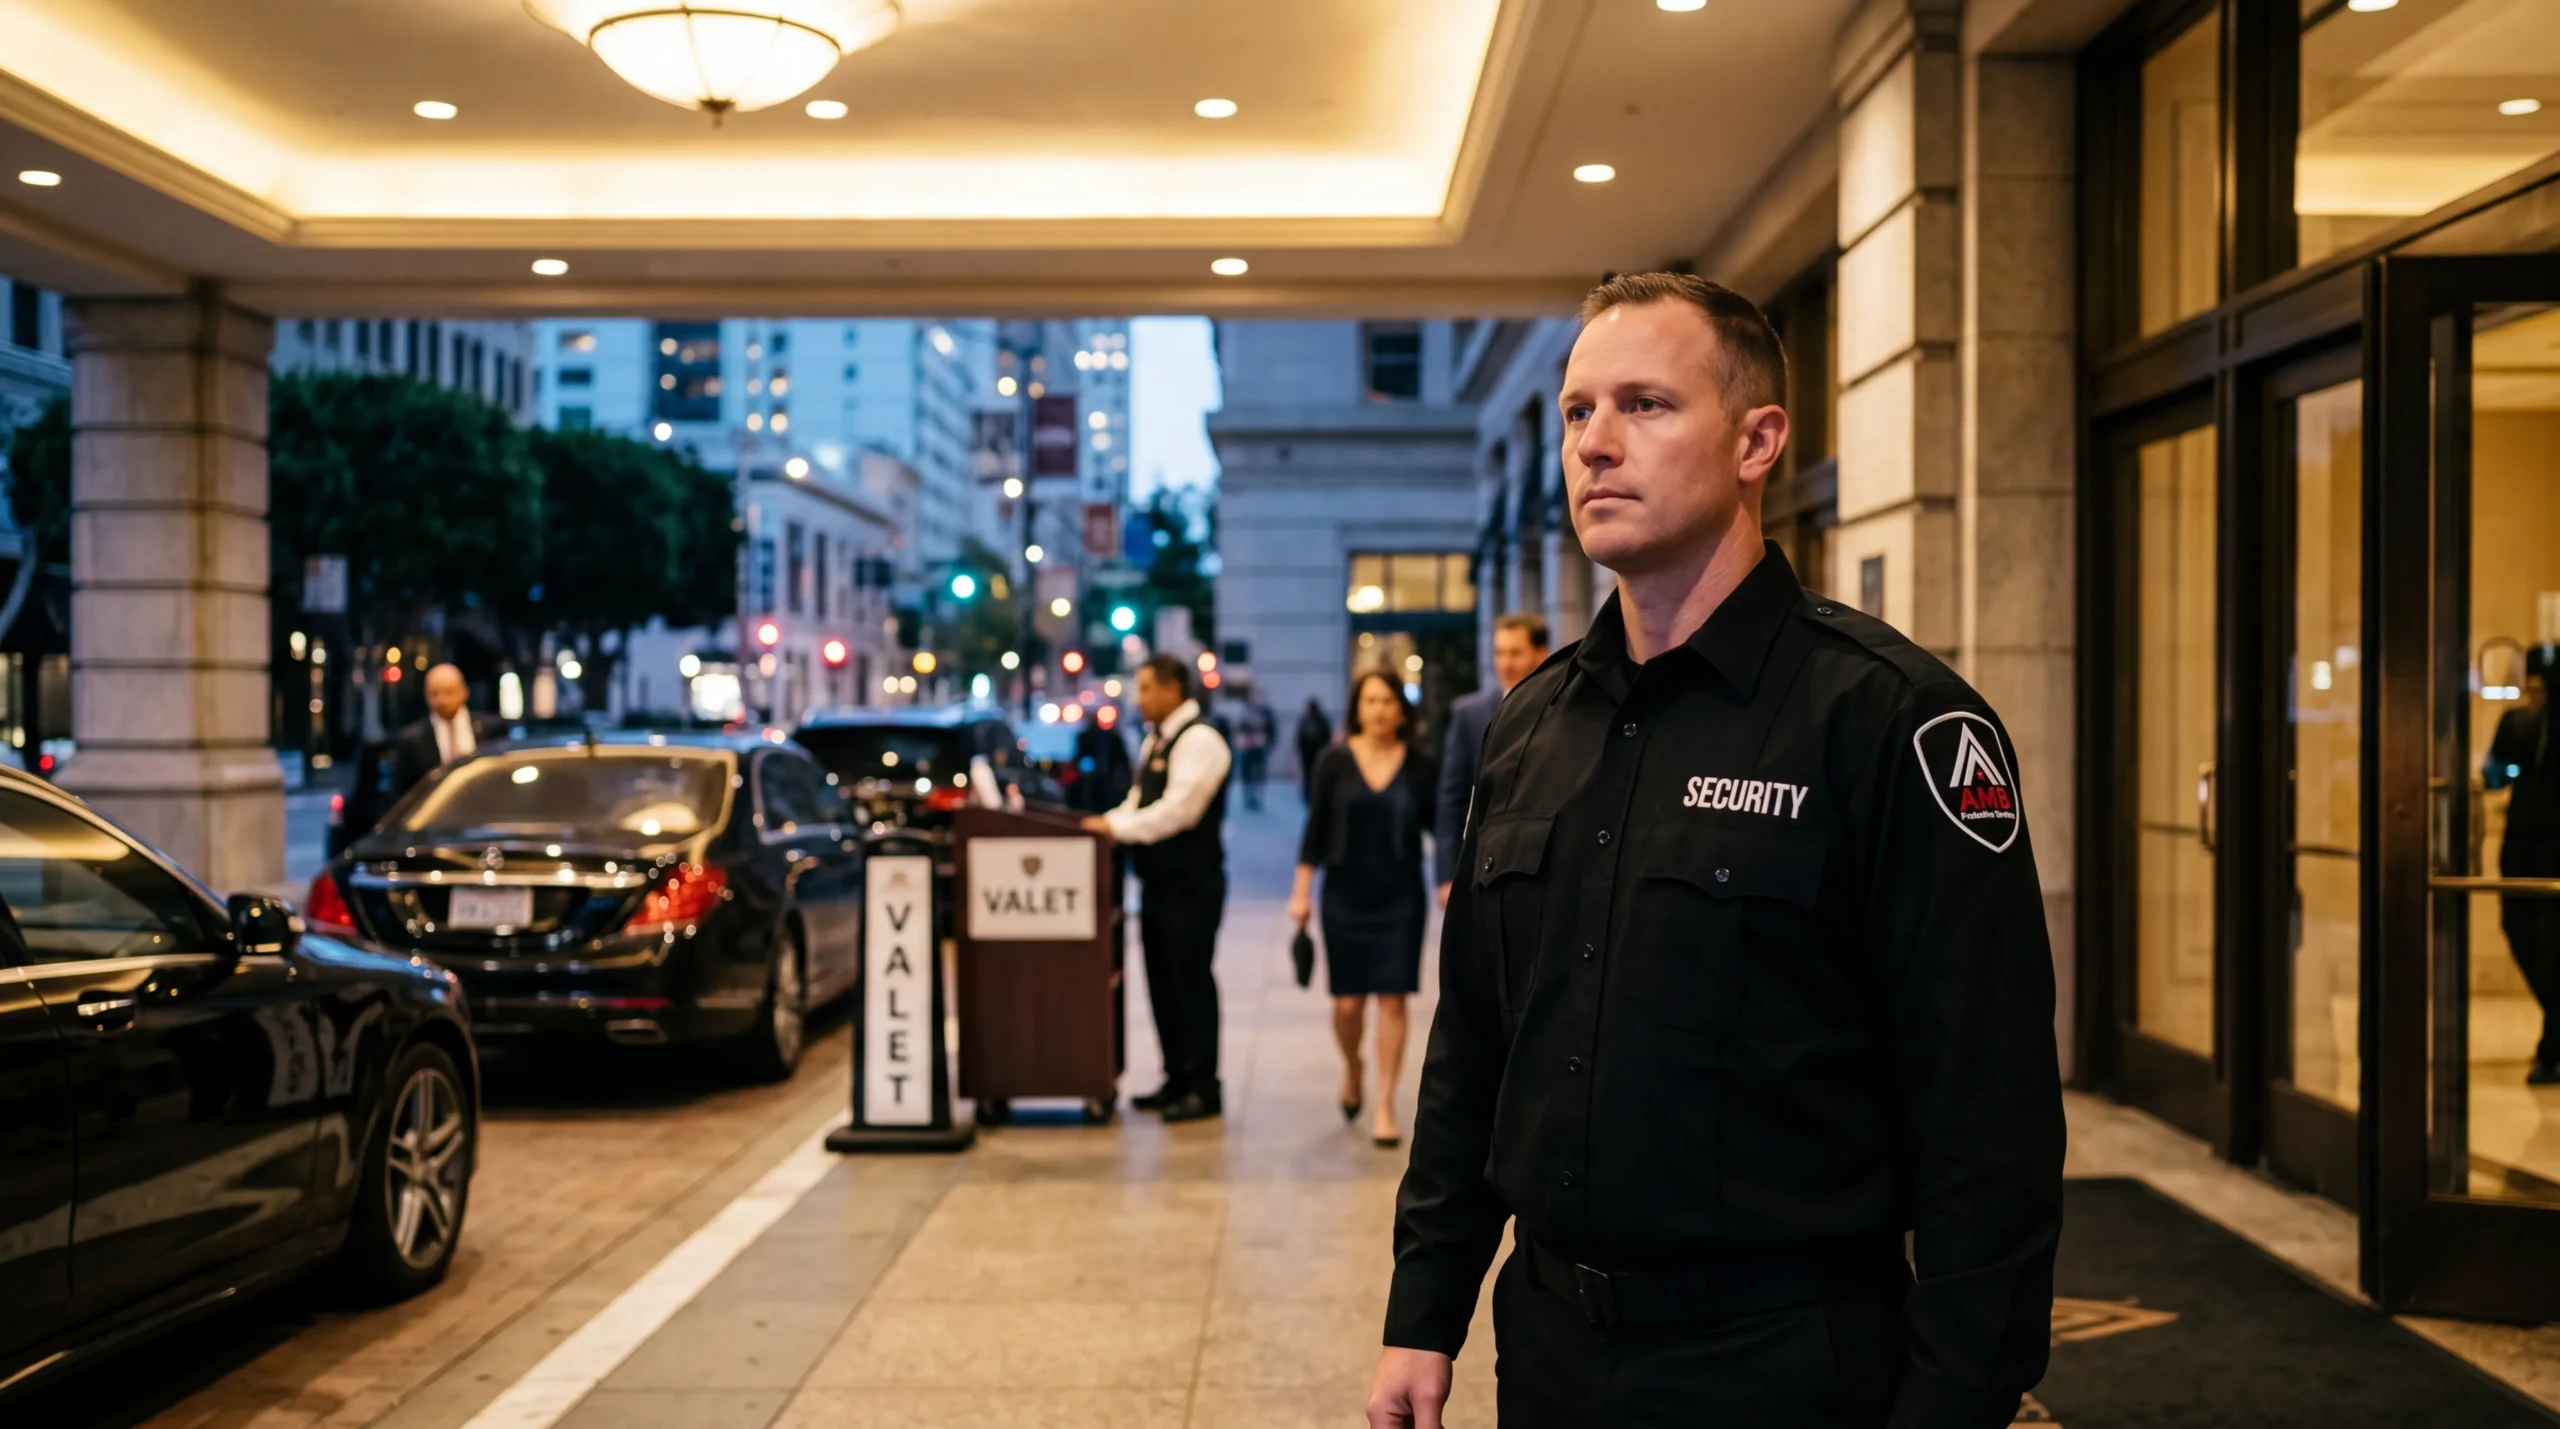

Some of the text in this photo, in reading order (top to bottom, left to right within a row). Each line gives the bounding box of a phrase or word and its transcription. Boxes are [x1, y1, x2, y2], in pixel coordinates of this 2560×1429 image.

[1683, 775, 1809, 819] SECURITY
[1960, 786, 2011, 812] AMB
[983, 888, 1079, 915] VALET
[885, 902, 912, 1105] VALET
